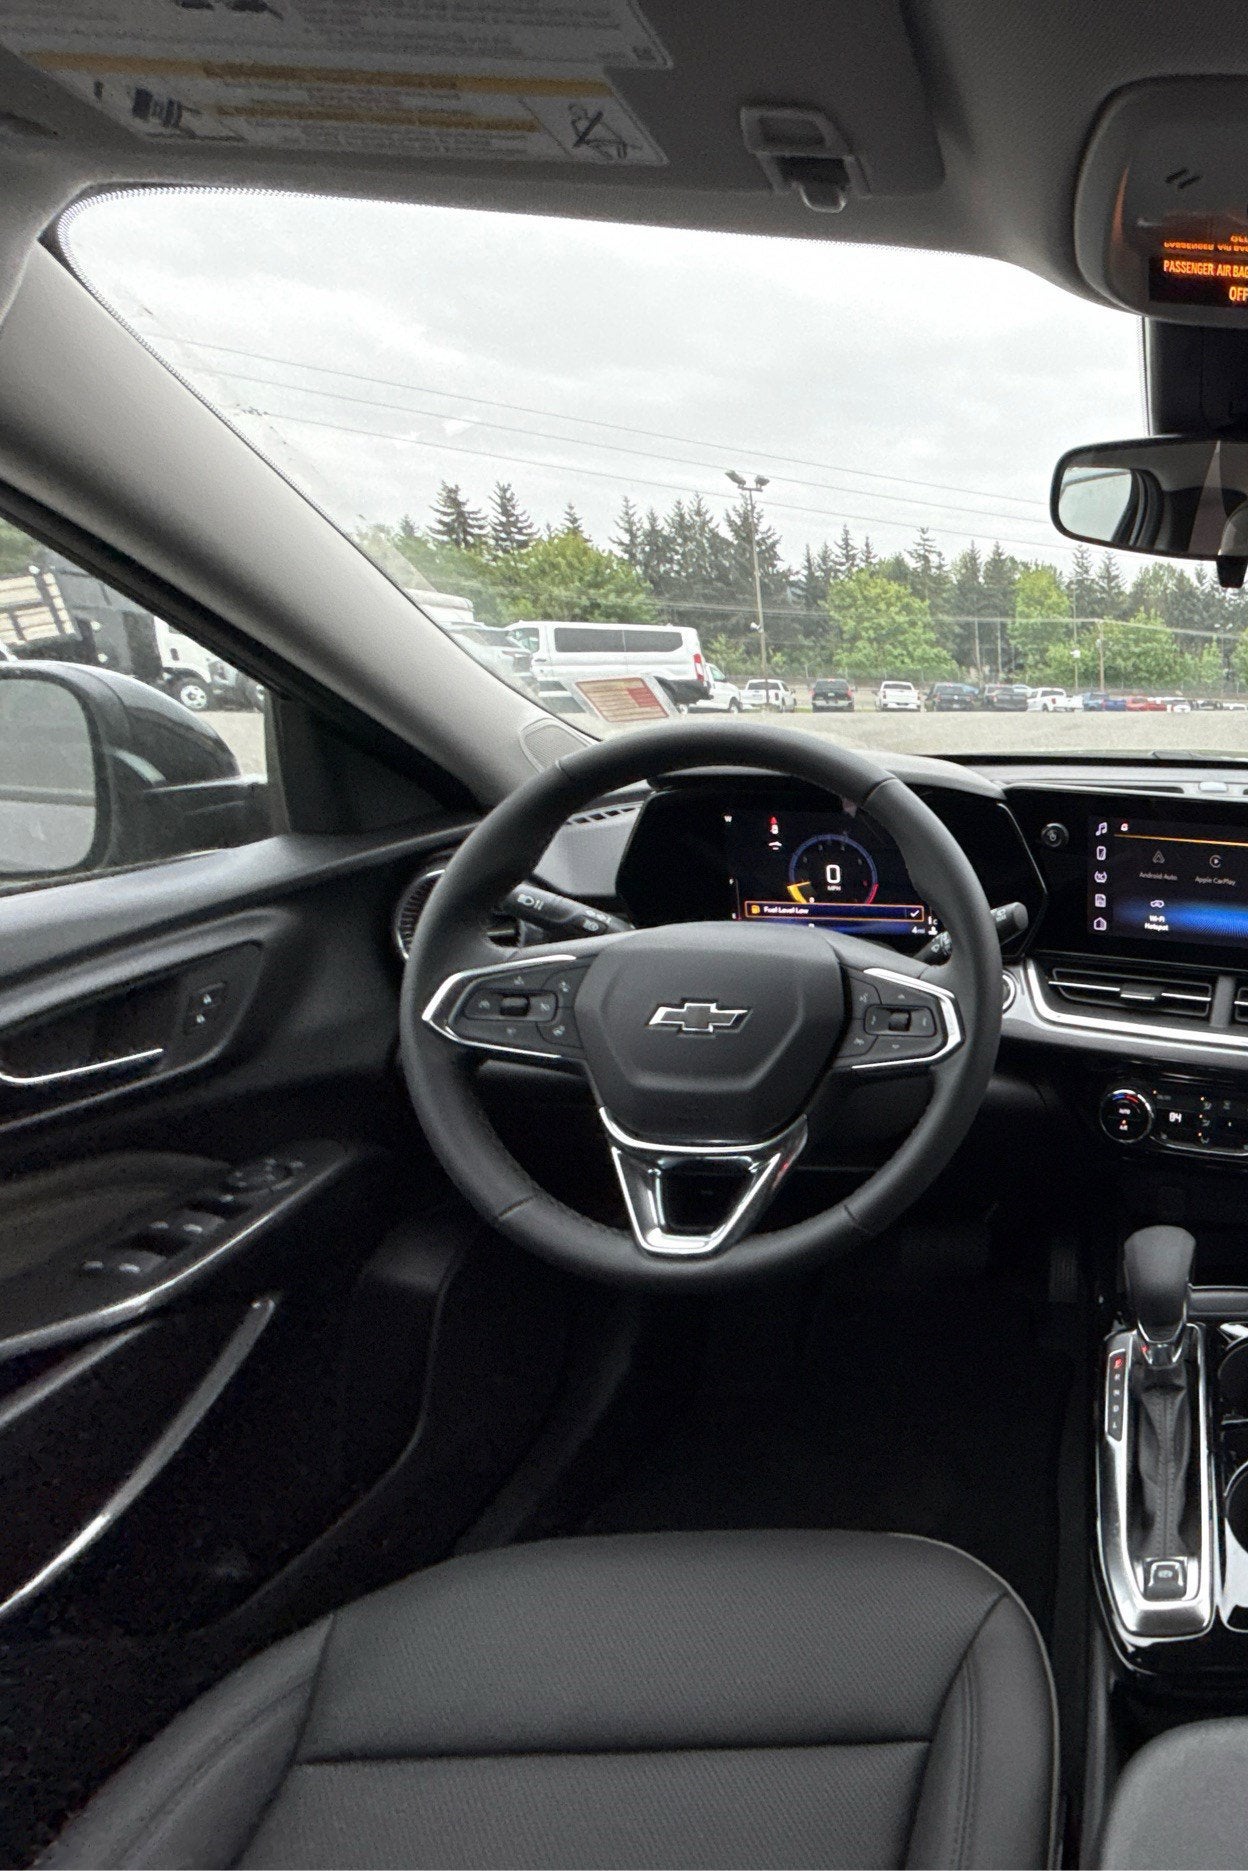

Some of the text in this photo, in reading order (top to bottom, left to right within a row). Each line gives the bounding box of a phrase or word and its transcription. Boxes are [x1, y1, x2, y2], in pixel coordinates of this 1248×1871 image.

[1163, 260, 1214, 276] PASSENGER
[1216, 264, 1231, 277] AIR
[826, 864, 841, 884] 0
[1139, 872, 1162, 880] Android
[1195, 876, 1236, 886] Apple CarPlay
[763, 905, 809, 914] Fuel Level Low
[1149, 915, 1165, 923] Wi-Fi
[1144, 922, 1169, 931] Hotspot
